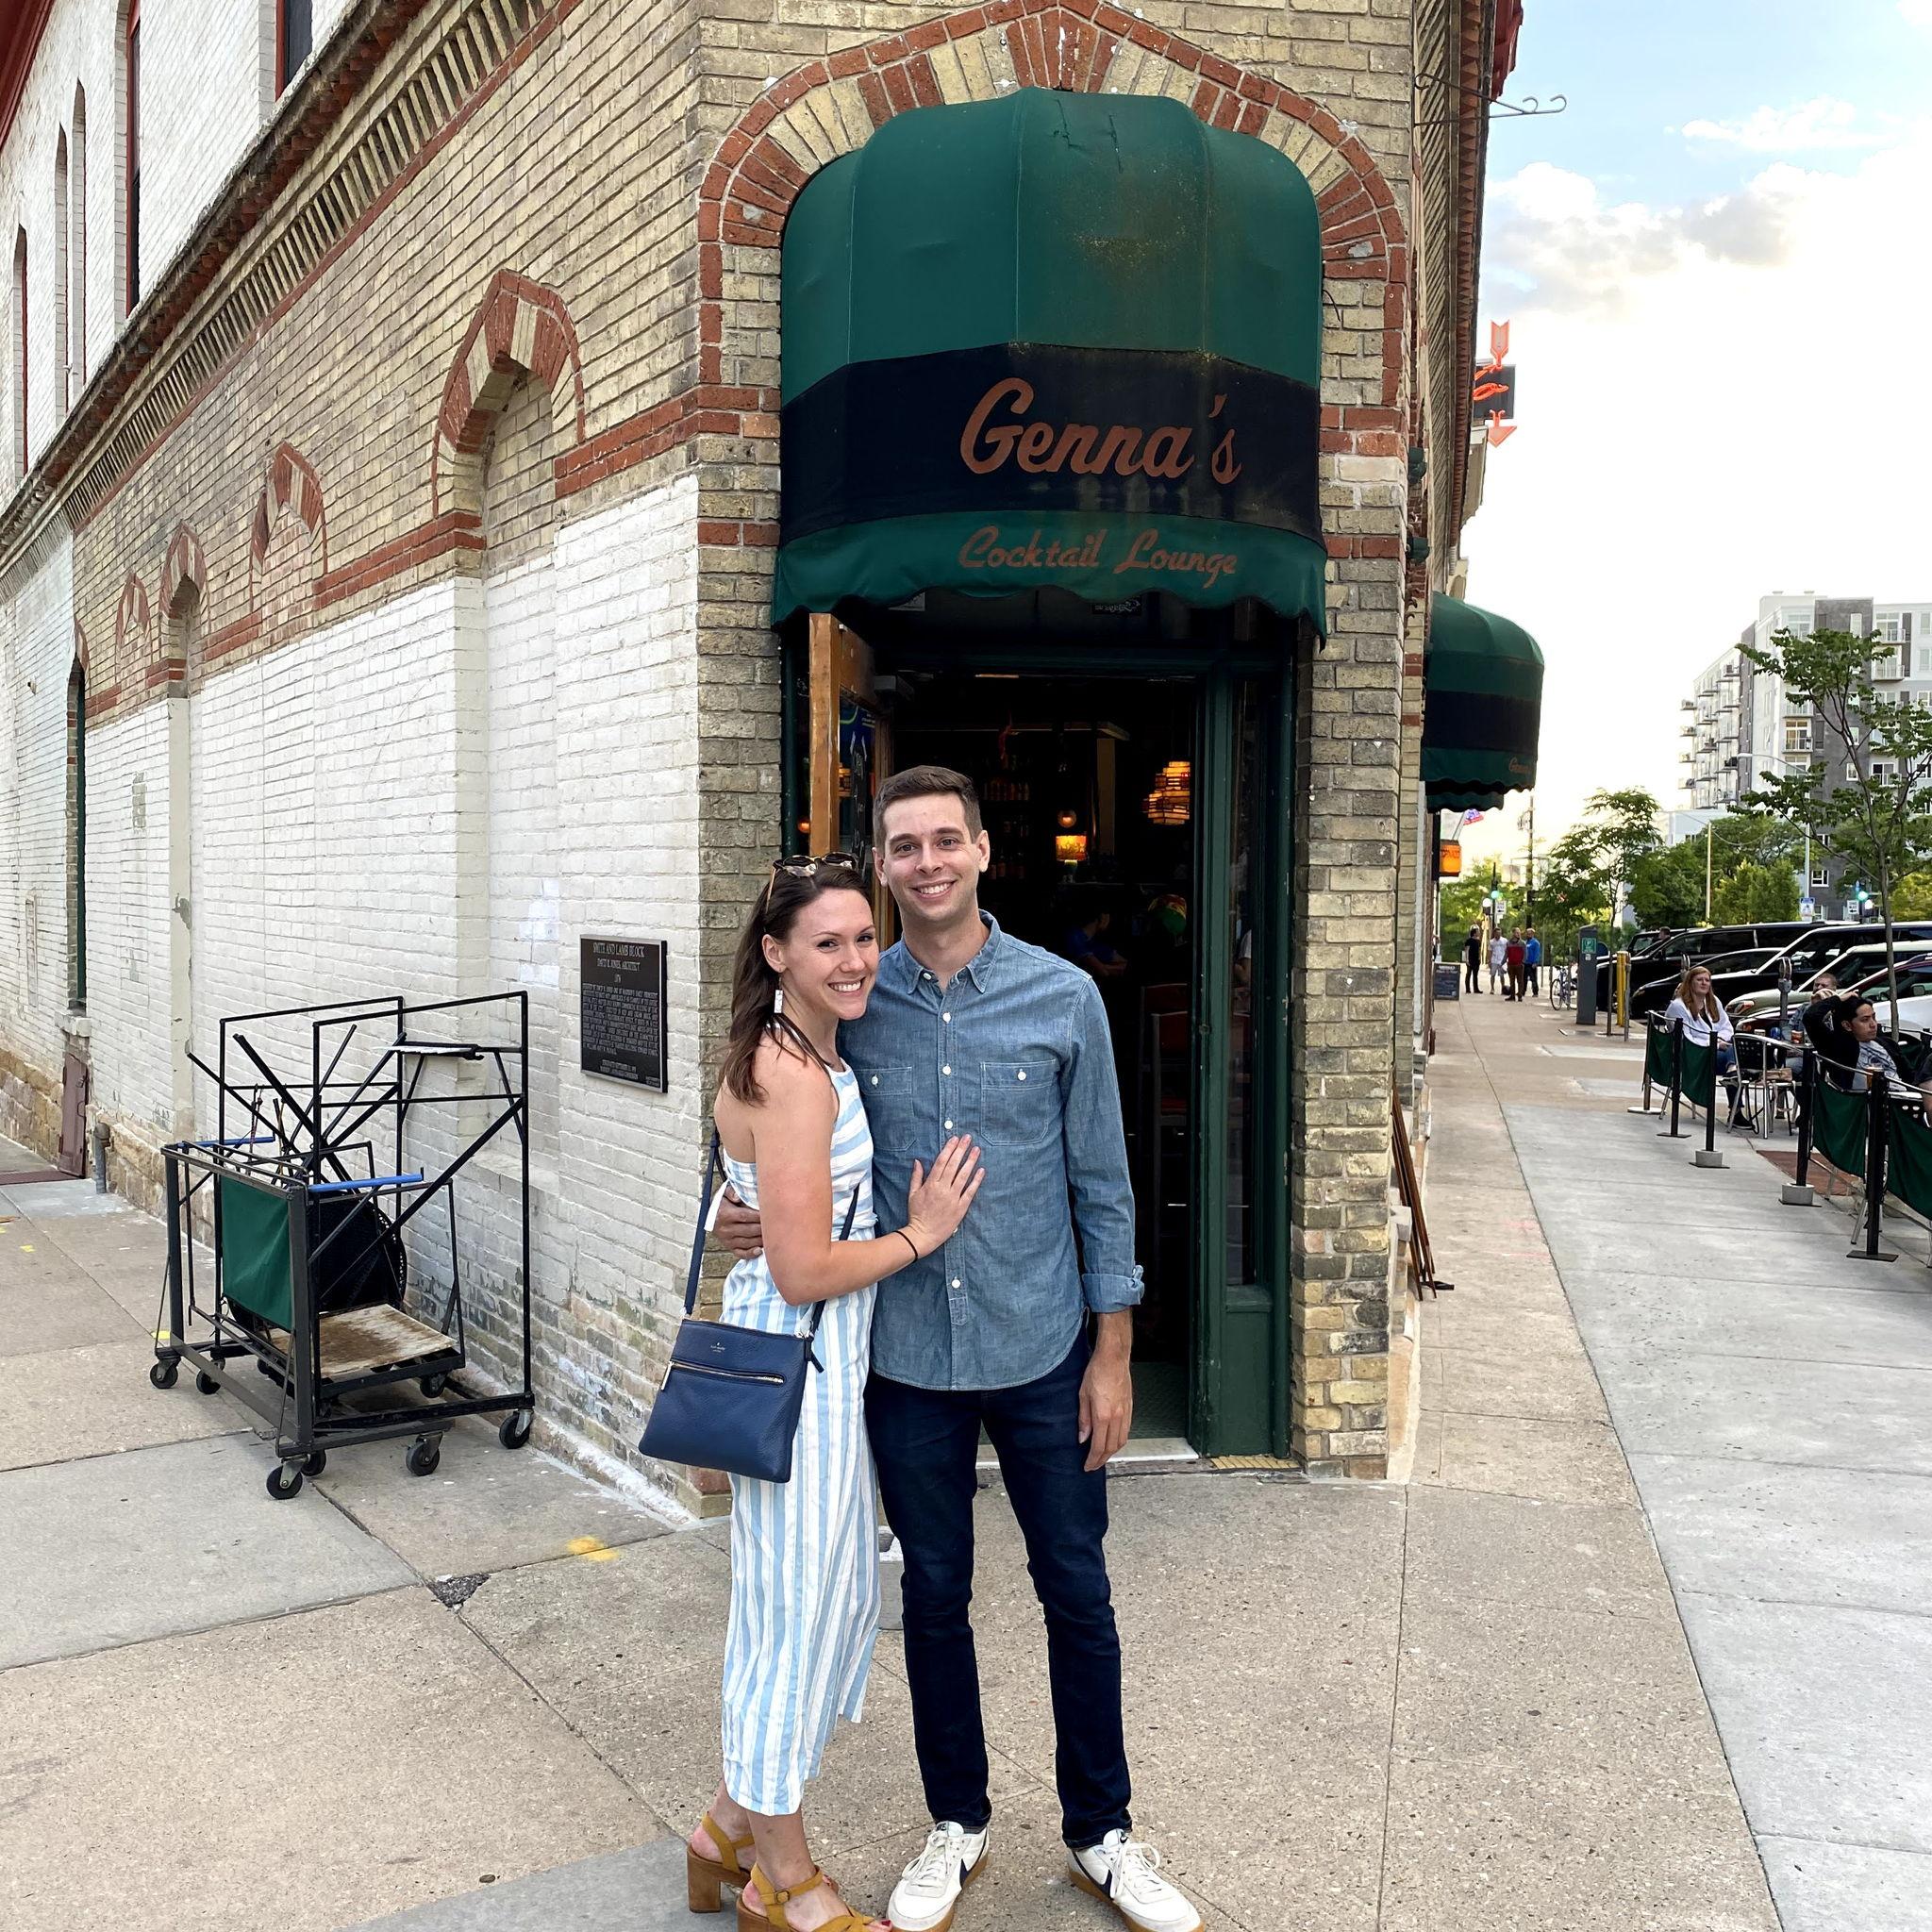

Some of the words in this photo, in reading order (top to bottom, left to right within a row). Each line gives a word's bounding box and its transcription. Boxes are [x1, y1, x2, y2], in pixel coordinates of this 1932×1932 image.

[960, 377, 1242, 484] Genna's
[958, 525, 1108, 568] Cocktail
[1113, 528, 1238, 589] Lounge
[628, 944, 644, 958] BLOCK
